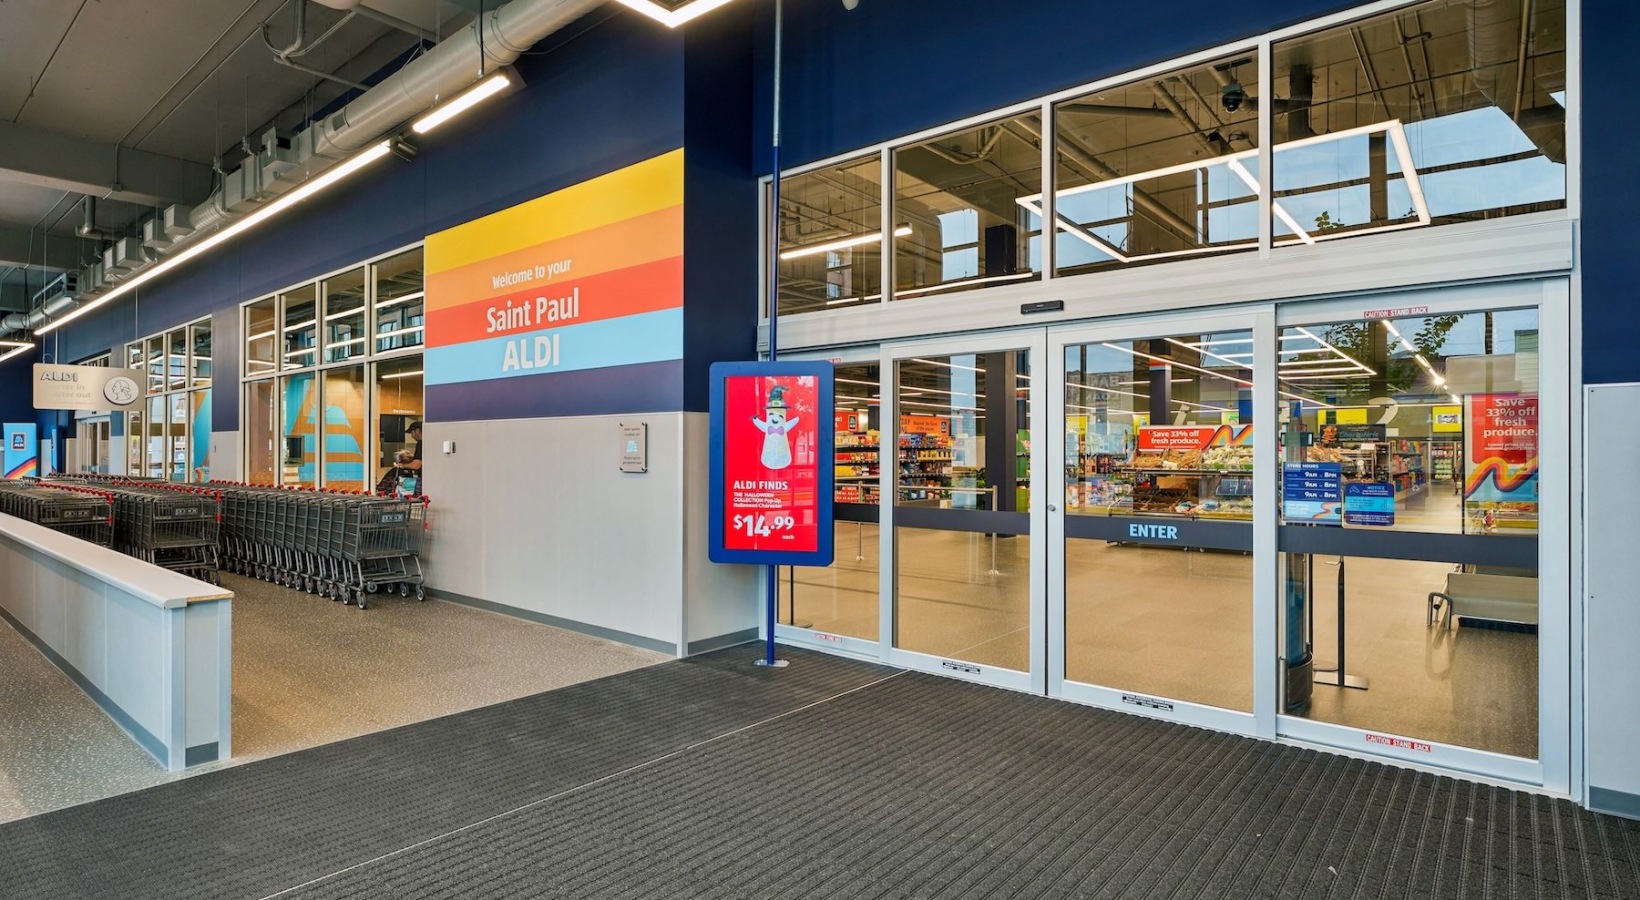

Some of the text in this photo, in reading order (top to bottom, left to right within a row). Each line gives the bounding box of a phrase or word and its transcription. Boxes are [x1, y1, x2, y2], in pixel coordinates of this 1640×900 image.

[492, 259, 573, 289] Welcome to your
[486, 287, 579, 333] Saint Paul
[1365, 306, 1427, 318] CAUTION STAND BACK
[502, 333, 560, 372] ALDI
[40, 371, 79, 382] ALDI
[1495, 399, 1526, 407] Save
[1486, 407, 1536, 417] 33% off
[1495, 417, 1527, 426] fresh
[1152, 430, 1170, 438] Save
[1171, 430, 1188, 438] 33%
[1483, 428, 1538, 438] produce.
[1170, 437, 1201, 446] produce.
[733, 480, 788, 491] ALDI FINDS
[733, 514, 795, 537] $14.99
[1129, 523, 1178, 539] ENTER
[1367, 735, 1431, 752] CAUTION STAND BACK
